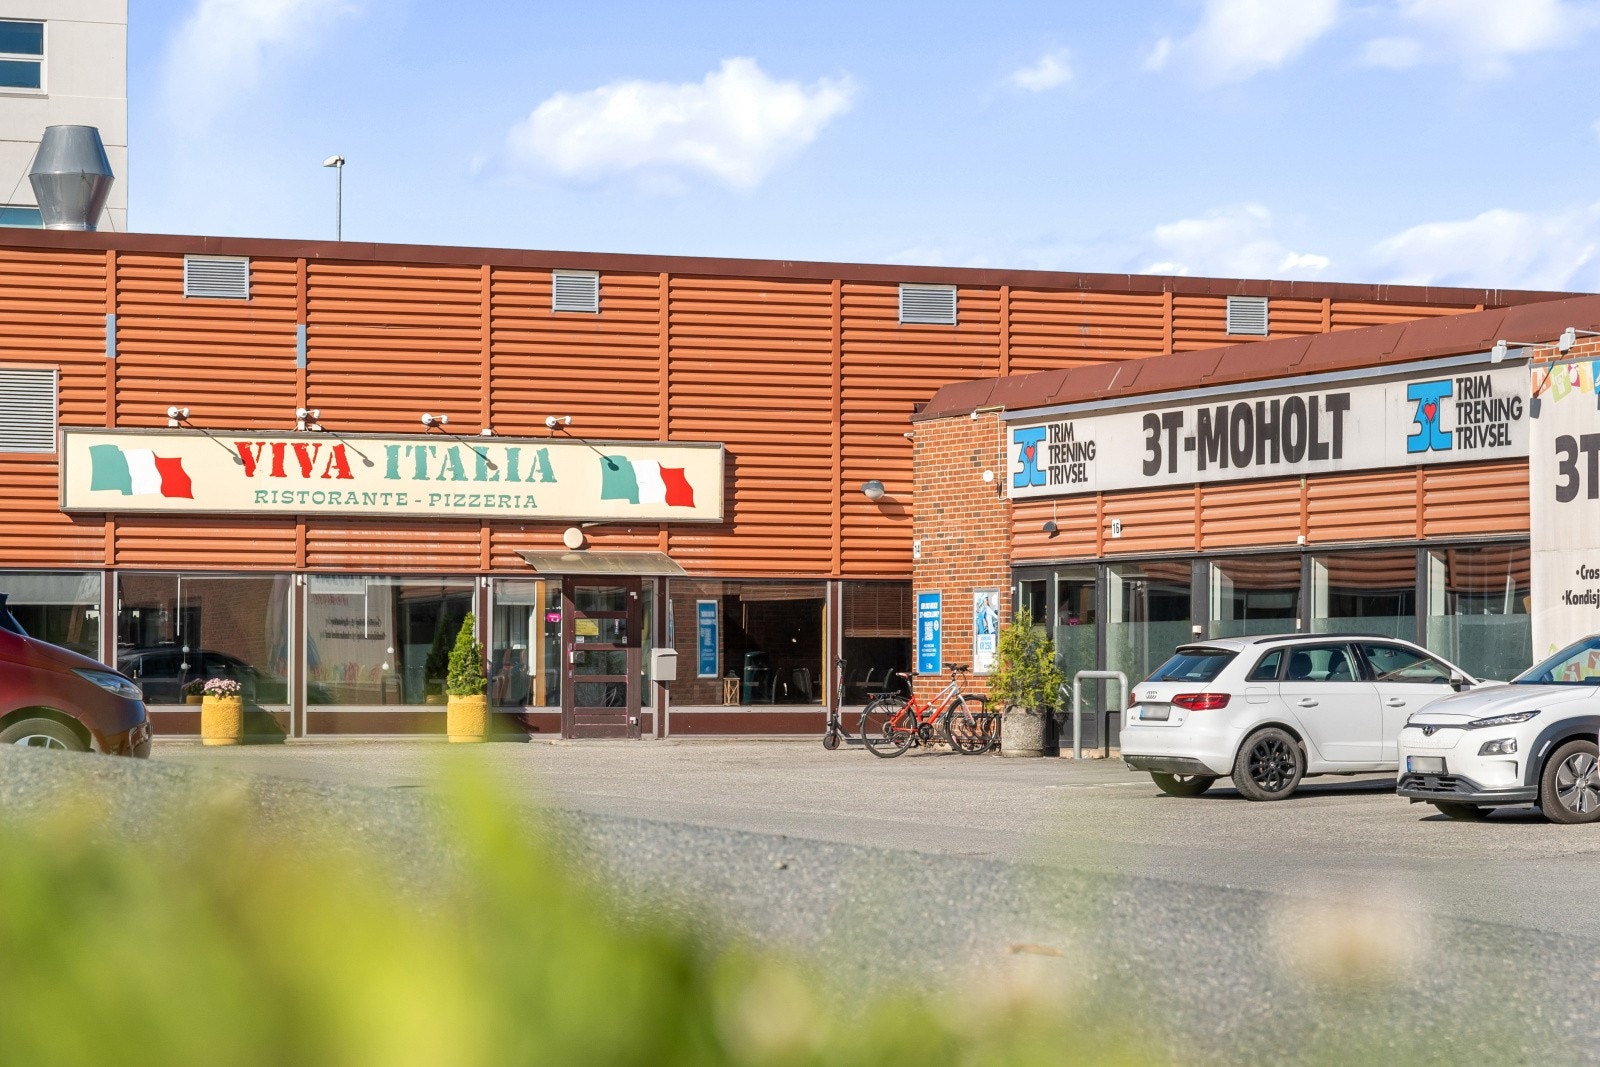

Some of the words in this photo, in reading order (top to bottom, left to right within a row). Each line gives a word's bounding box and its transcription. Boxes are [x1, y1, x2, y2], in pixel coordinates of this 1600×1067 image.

[1455, 374, 1493, 401] TRIM
[1455, 396, 1523, 426] TRENING
[1048, 422, 1075, 444] TRIM
[1142, 391, 1351, 477] 3T-MOHOLT
[1455, 422, 1512, 450] TRIVSEL
[234, 441, 355, 480] VIVA
[383, 444, 558, 484] ITALIA
[1048, 440, 1096, 468] TRENING
[1048, 462, 1089, 486] TRIVSEL
[254, 489, 408, 506] RISTORANTE
[428, 492, 538, 509] PIZZERIA
[1112, 522, 1120, 535] 16
